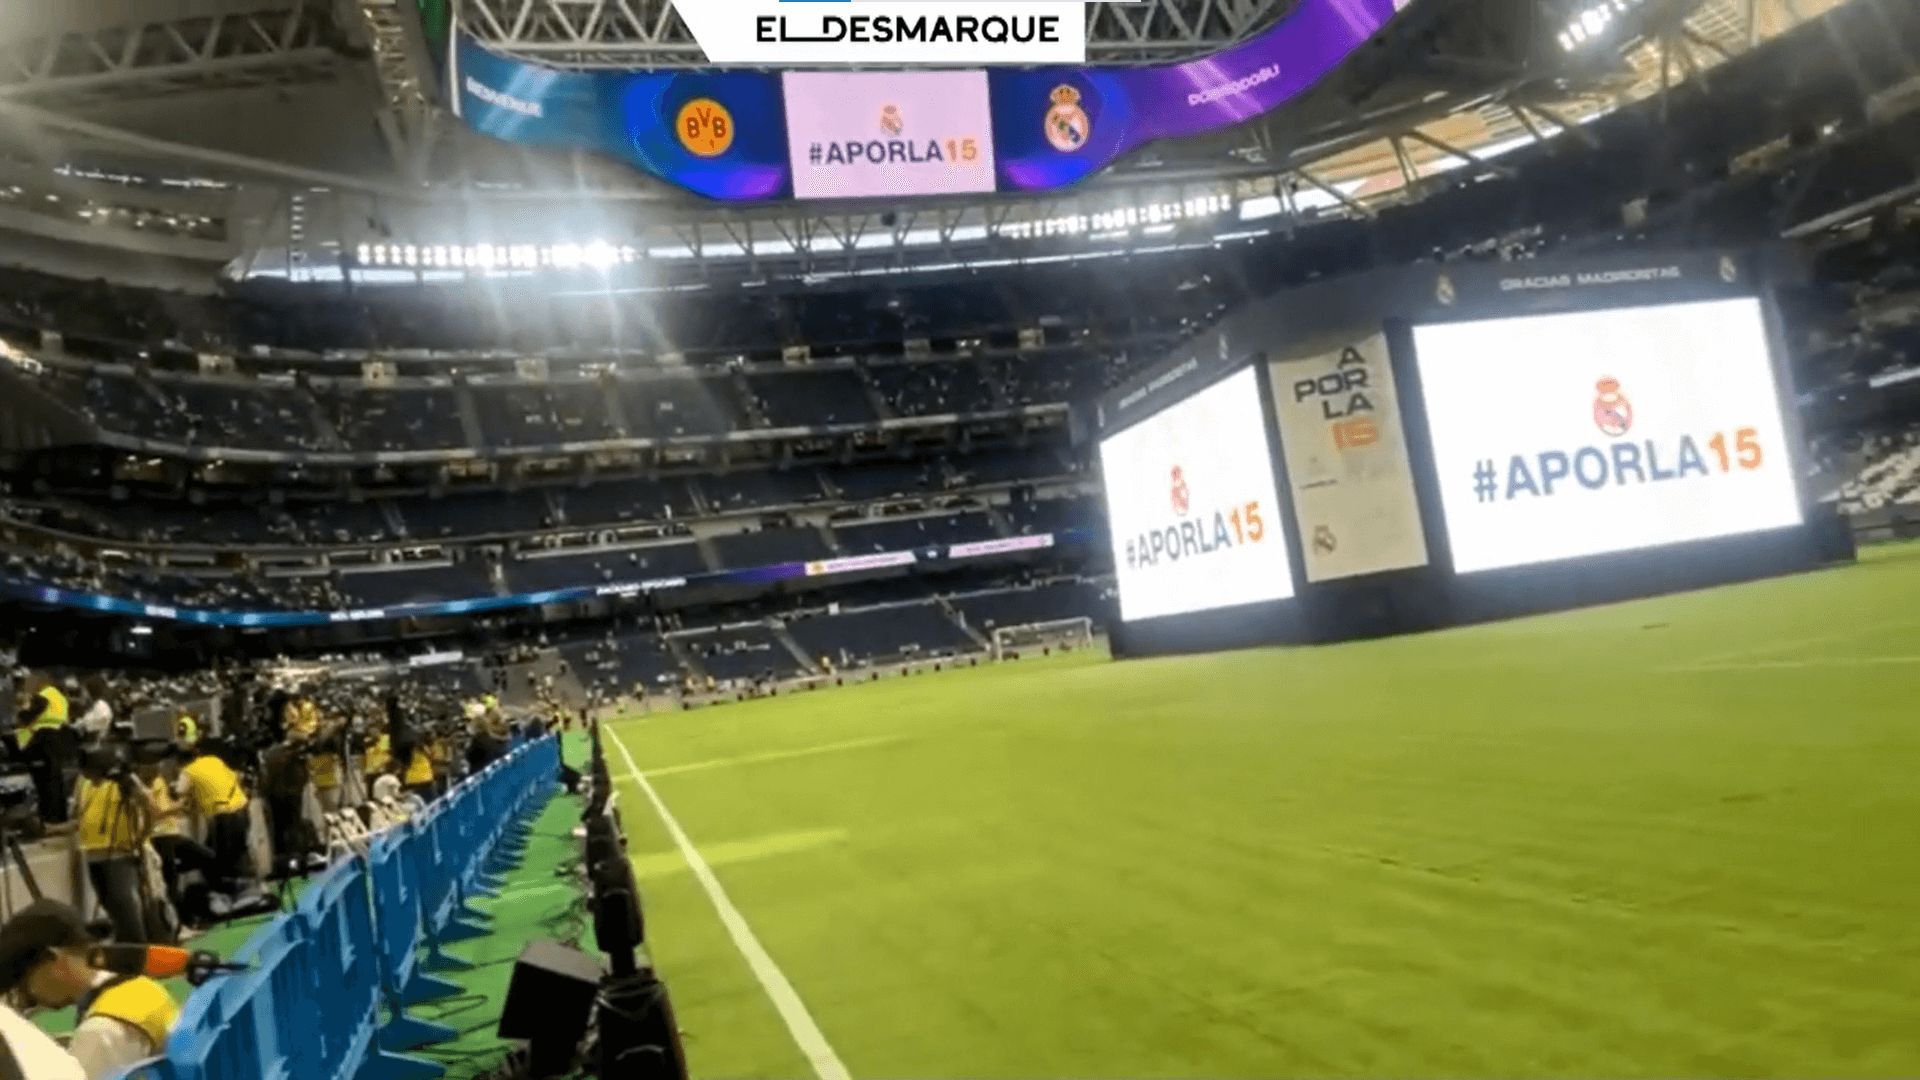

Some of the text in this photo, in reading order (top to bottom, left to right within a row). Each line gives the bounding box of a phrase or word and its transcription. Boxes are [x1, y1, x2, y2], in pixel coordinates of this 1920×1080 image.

[686, 106, 727, 139] BVB
[809, 137, 978, 165] #APORLA15
[1337, 344, 1366, 370] A
[1293, 369, 1371, 403] POR
[1321, 393, 1375, 421] LA
[1471, 425, 1763, 504] #APORLA15
[1125, 500, 1266, 570] #APORLA15
